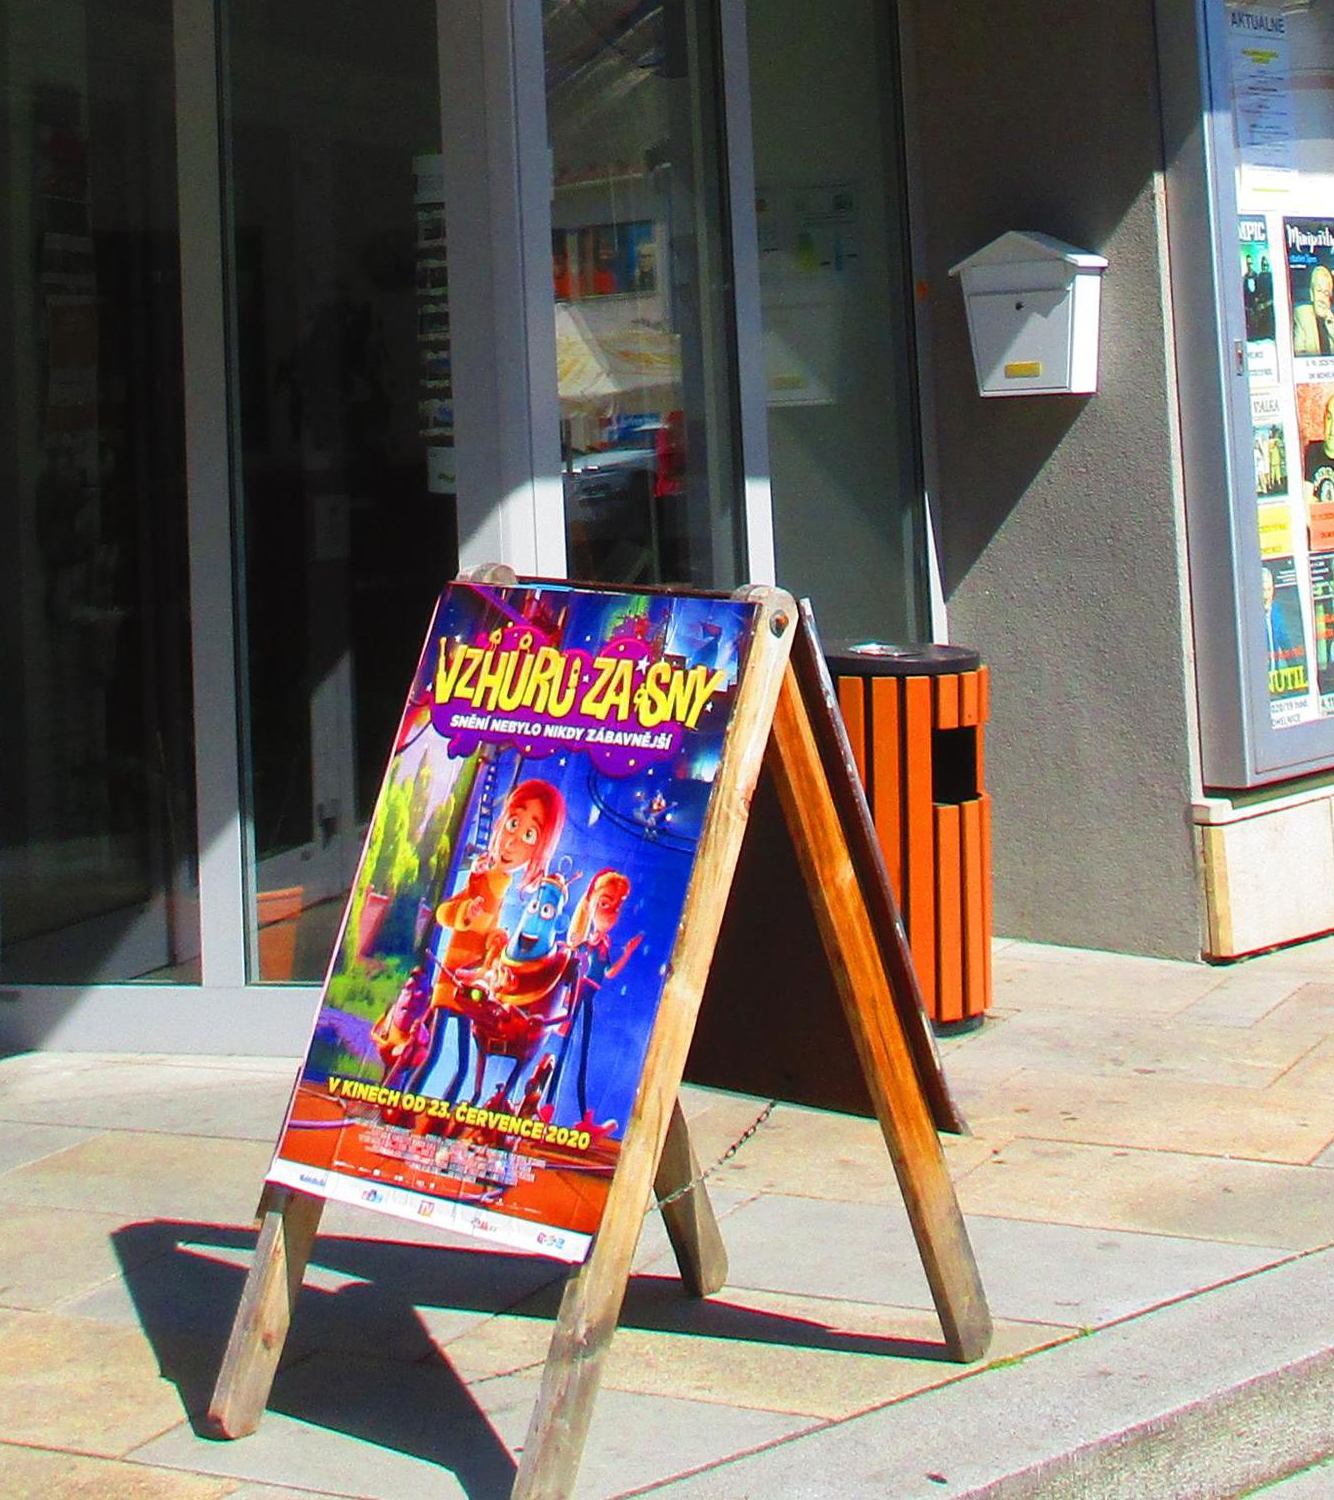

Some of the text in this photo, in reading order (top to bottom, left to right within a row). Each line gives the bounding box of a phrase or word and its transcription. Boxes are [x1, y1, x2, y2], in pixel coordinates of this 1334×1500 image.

[434, 630, 727, 730] VZHŮRU ZA SNY
[450, 714, 673, 750] SNĚNÍ NEBYLO NIKDY ZÁBAVNĚJŠÍ
[328, 1076, 591, 1151] V KINECH OD 23. ČERVENCE 2020
